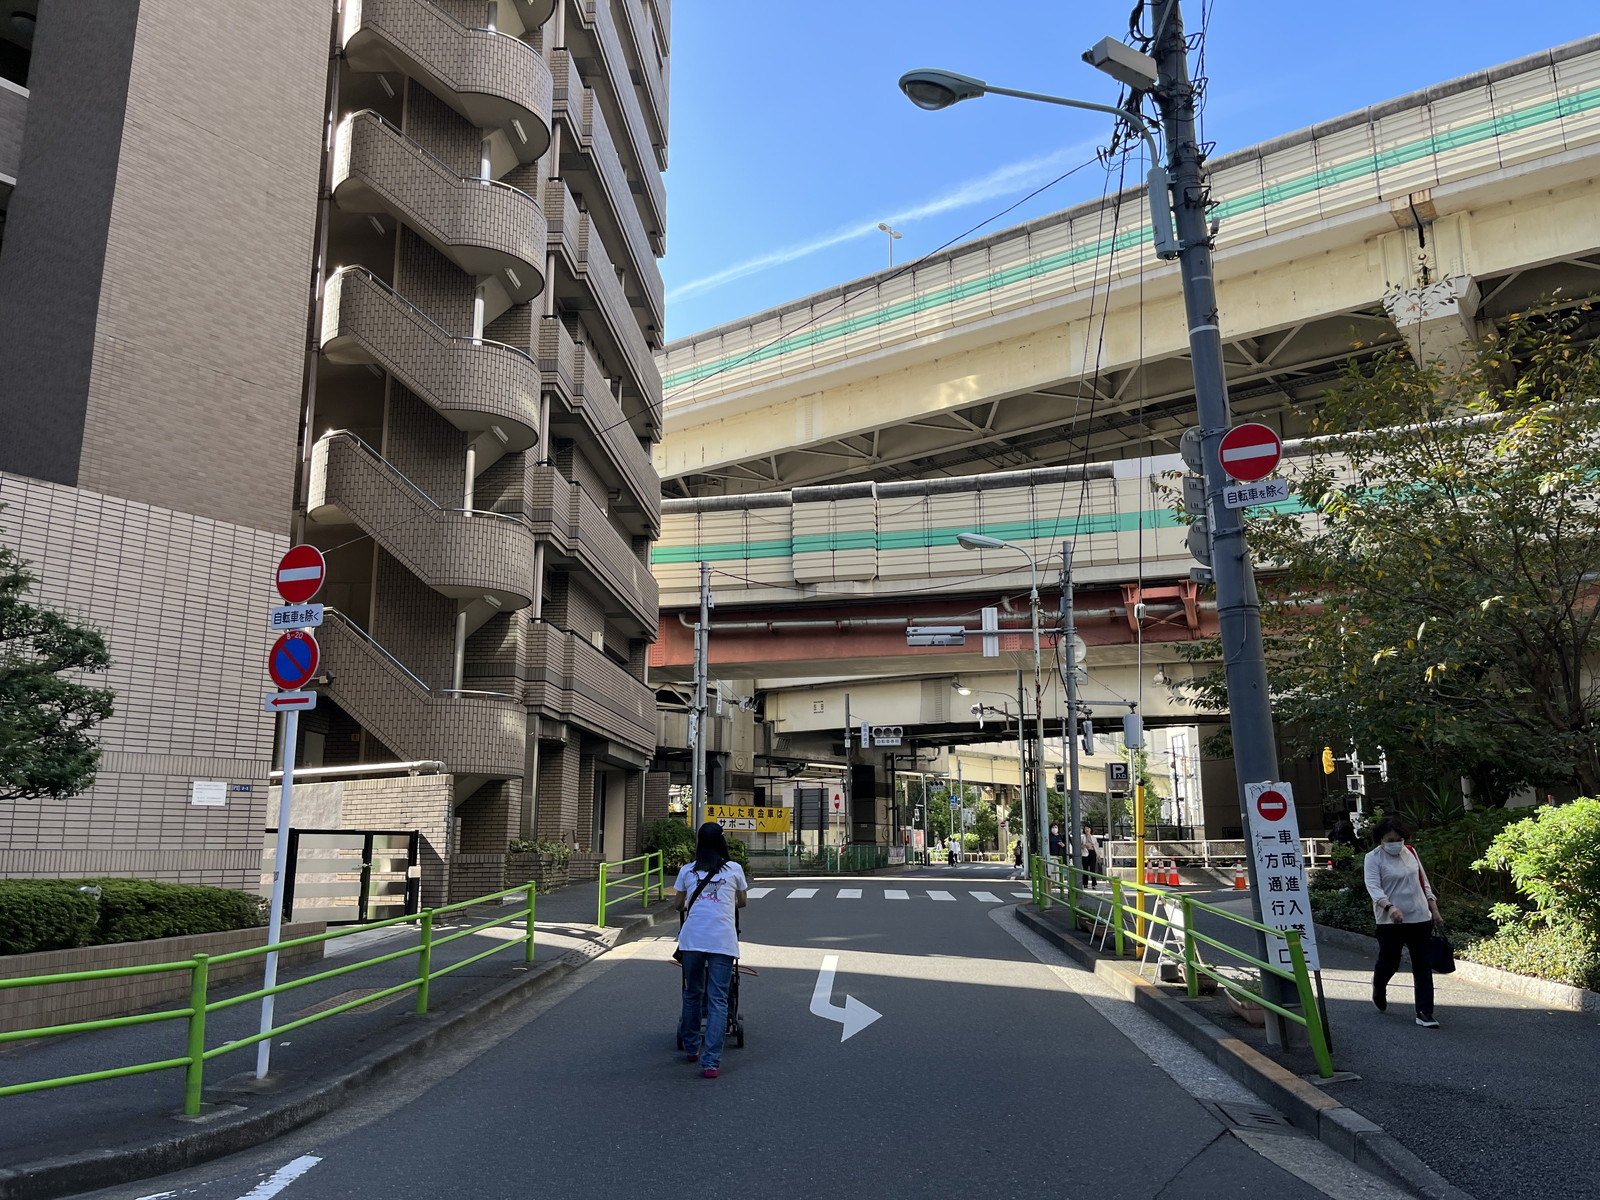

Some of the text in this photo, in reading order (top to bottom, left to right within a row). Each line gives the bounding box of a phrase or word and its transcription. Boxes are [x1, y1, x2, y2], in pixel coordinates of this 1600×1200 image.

[1227, 485, 1284, 504] 自転車を除く
[273, 609, 320, 625] 自転車を除く
[287, 631, 303, 640] 8-20
[1113, 764, 1125, 779] P
[707, 806, 783, 819] 進入した現金車は
